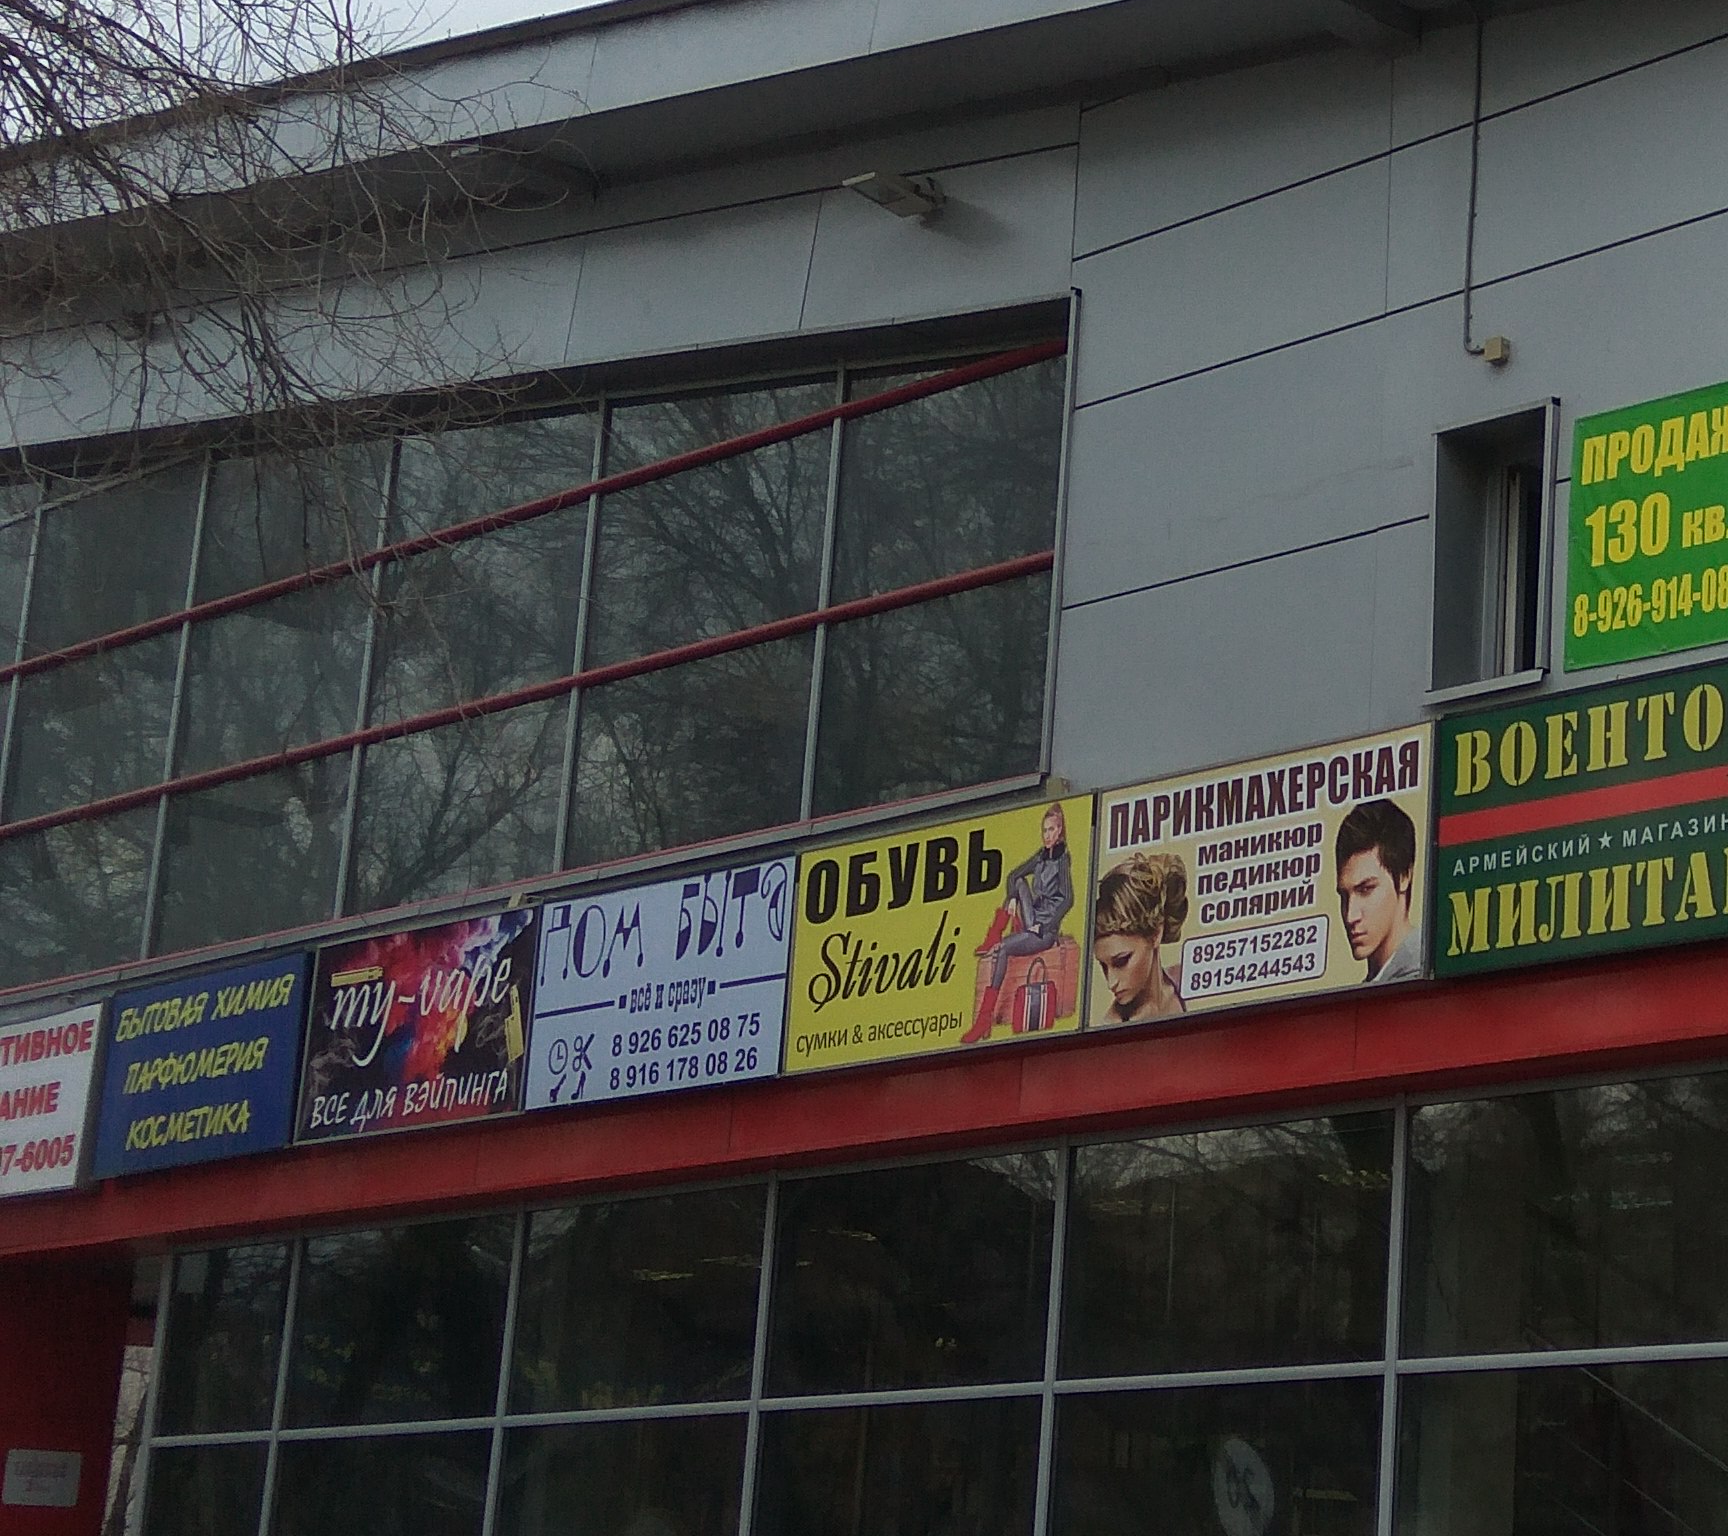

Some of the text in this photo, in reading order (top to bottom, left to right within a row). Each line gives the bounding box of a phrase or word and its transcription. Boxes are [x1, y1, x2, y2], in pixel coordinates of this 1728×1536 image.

[1585, 491, 1671, 567] 130
[1109, 740, 1420, 849] ПАРИКМАХЕРСКАЯ
[1198, 823, 1323, 866] маникюр
[1453, 833, 1591, 876] АРМЕЙСКИЙ
[805, 829, 1003, 925] ОБУВЬ
[1197, 852, 1321, 895] педикюр
[1200, 880, 1314, 924] солярий
[540, 901, 644, 987] ДОМ
[808, 910, 961, 1013] Stivali
[1192, 925, 1318, 964] 89257152282
[655, 983, 665, 1010] и
[668, 976, 706, 1013] сразу
[1190, 953, 1315, 992] 89154244543
[115, 973, 296, 1042] БЫТОВАЯ ХИМИЯ
[330, 954, 513, 1067] my-vape
[611, 1012, 761, 1057] 8 926 625 08 75
[796, 1011, 962, 1057] сумки & аксессуары
[123, 1036, 270, 1095] ПАРФЮМЕРИЯ
[609, 1046, 758, 1091] 8 916 178 08 26
[309, 1068, 508, 1133] ВСЕ ДЛЯ ВЭЙПИНГА
[125, 1099, 251, 1151] КОСМЕТИКА
[0, 1134, 76, 1177] 7-6005
